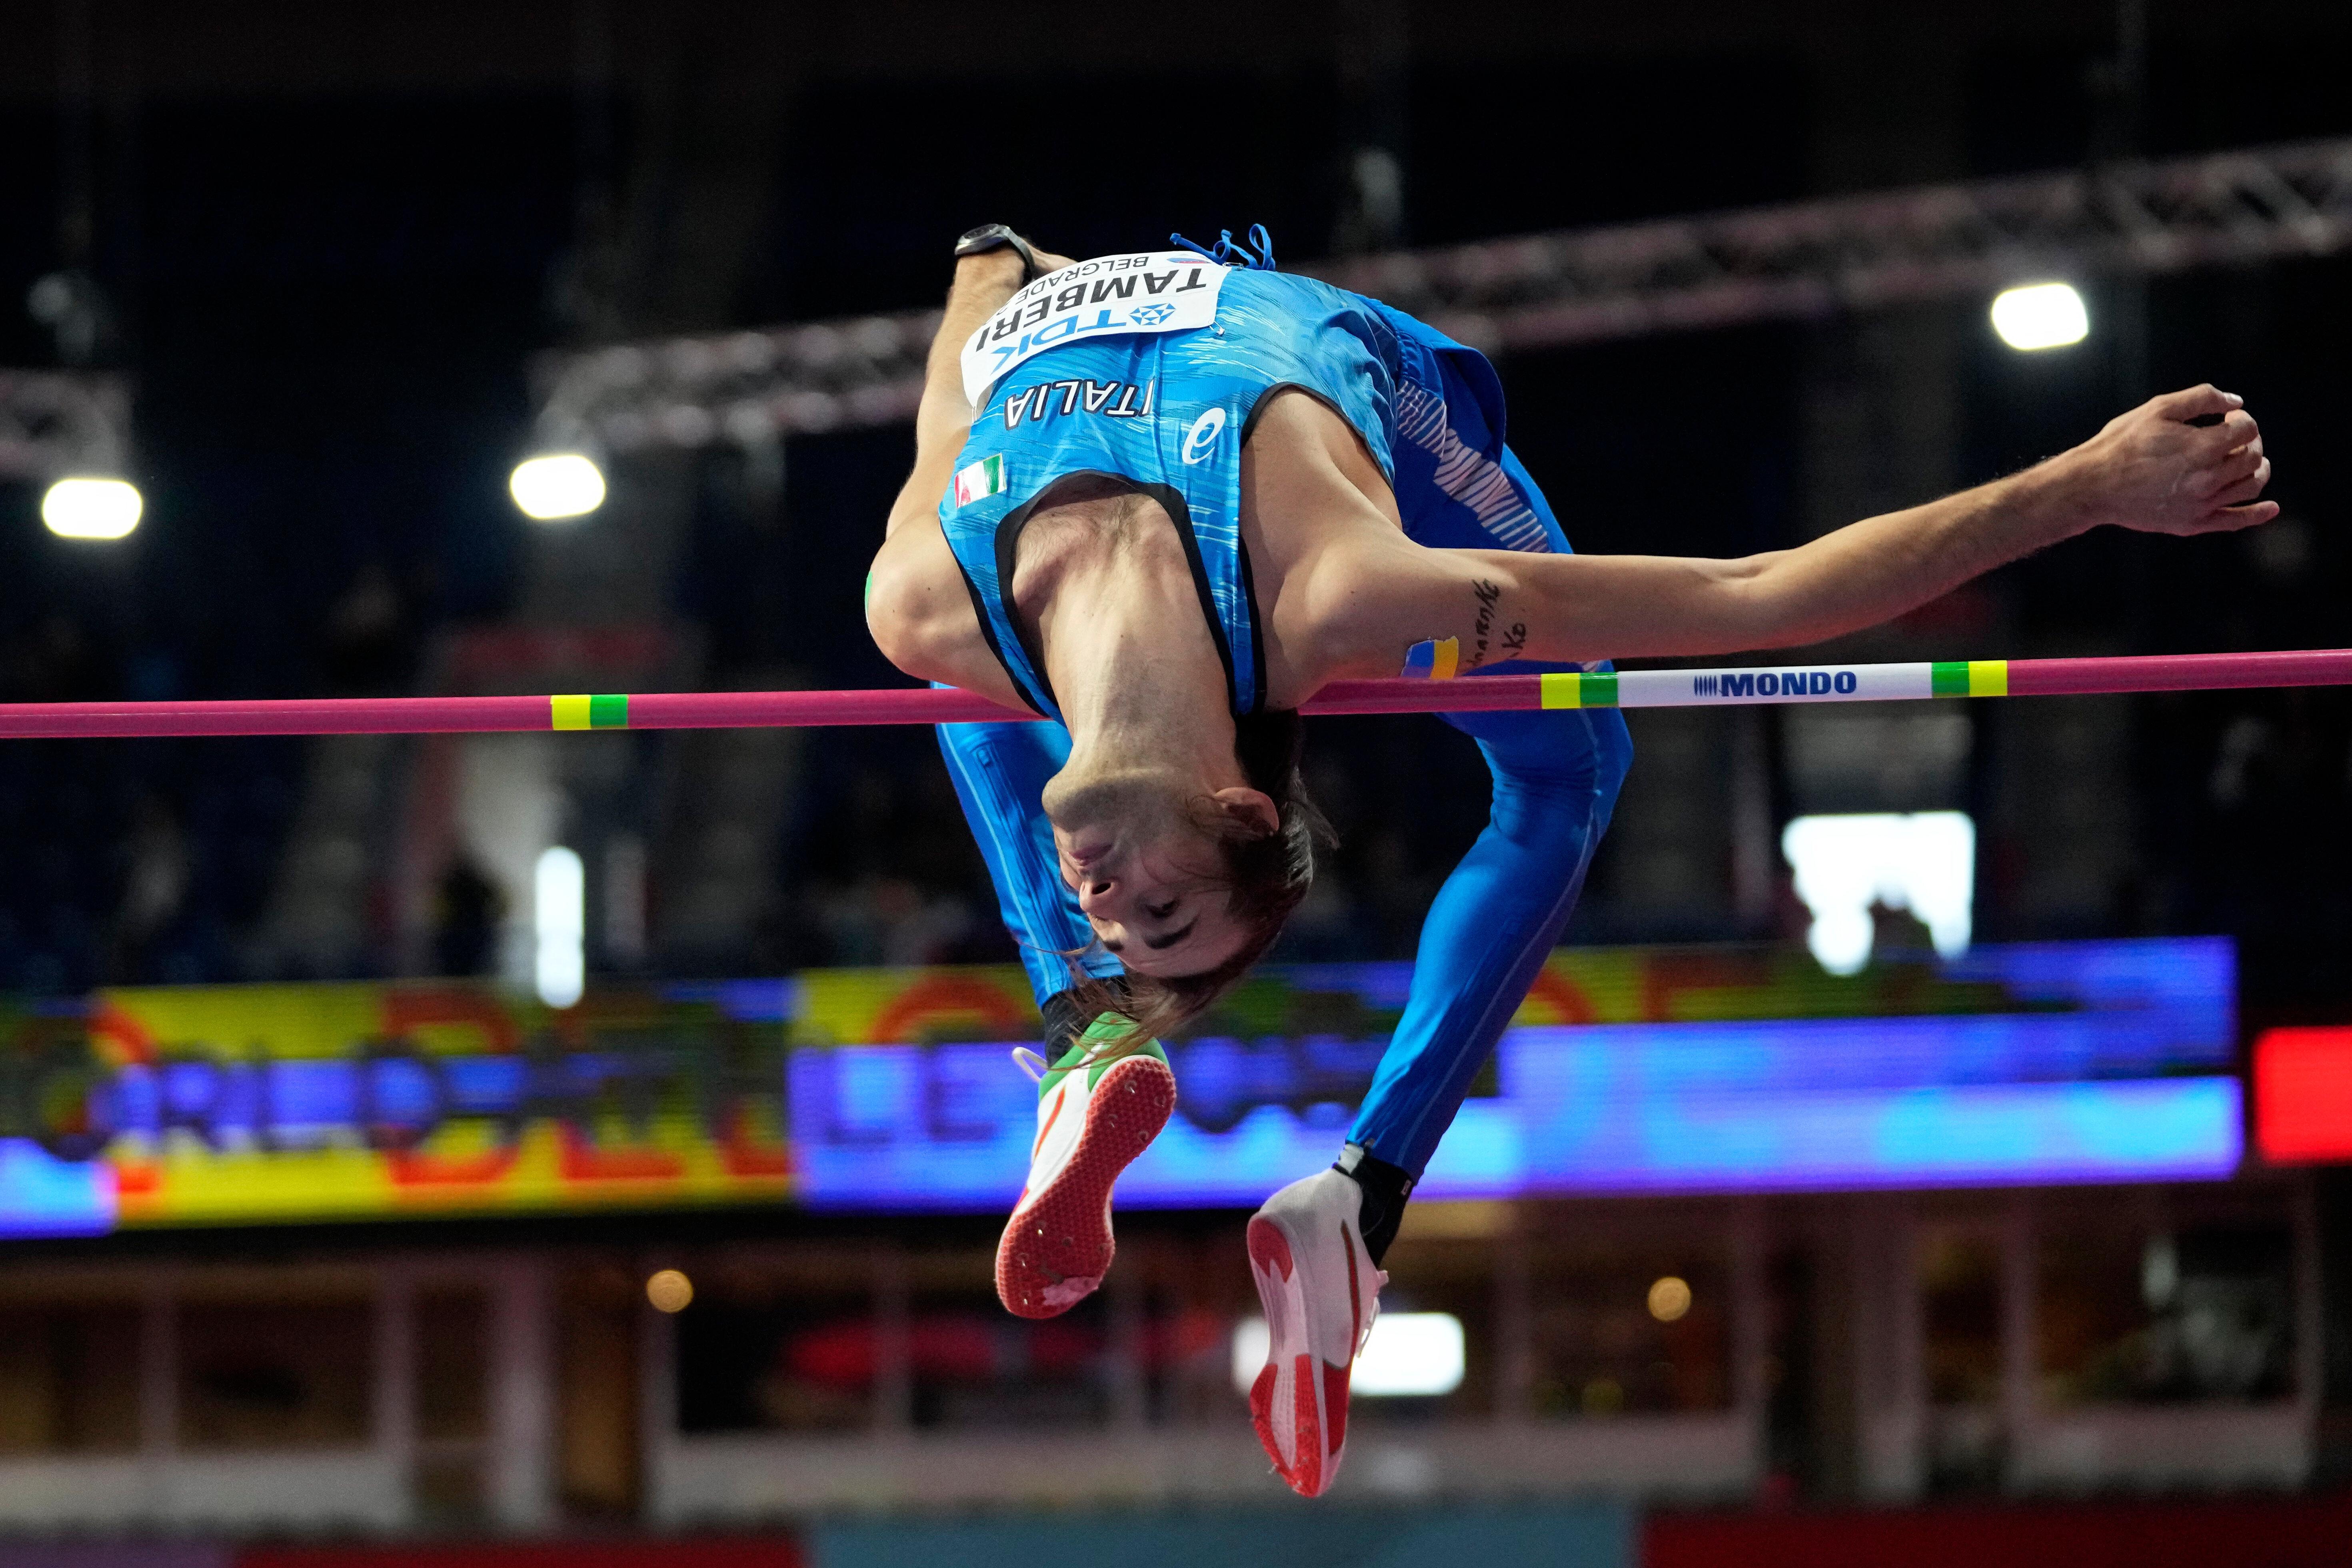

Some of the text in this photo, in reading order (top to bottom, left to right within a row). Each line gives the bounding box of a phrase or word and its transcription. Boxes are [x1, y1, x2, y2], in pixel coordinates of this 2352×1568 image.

[1015, 256, 1149, 305] BELGRADE
[975, 268, 1206, 352] TAMBERI
[990, 309, 1127, 376] TDK
[1005, 378, 1155, 430] ITALIA
[1721, 671, 1856, 697] MONDO
